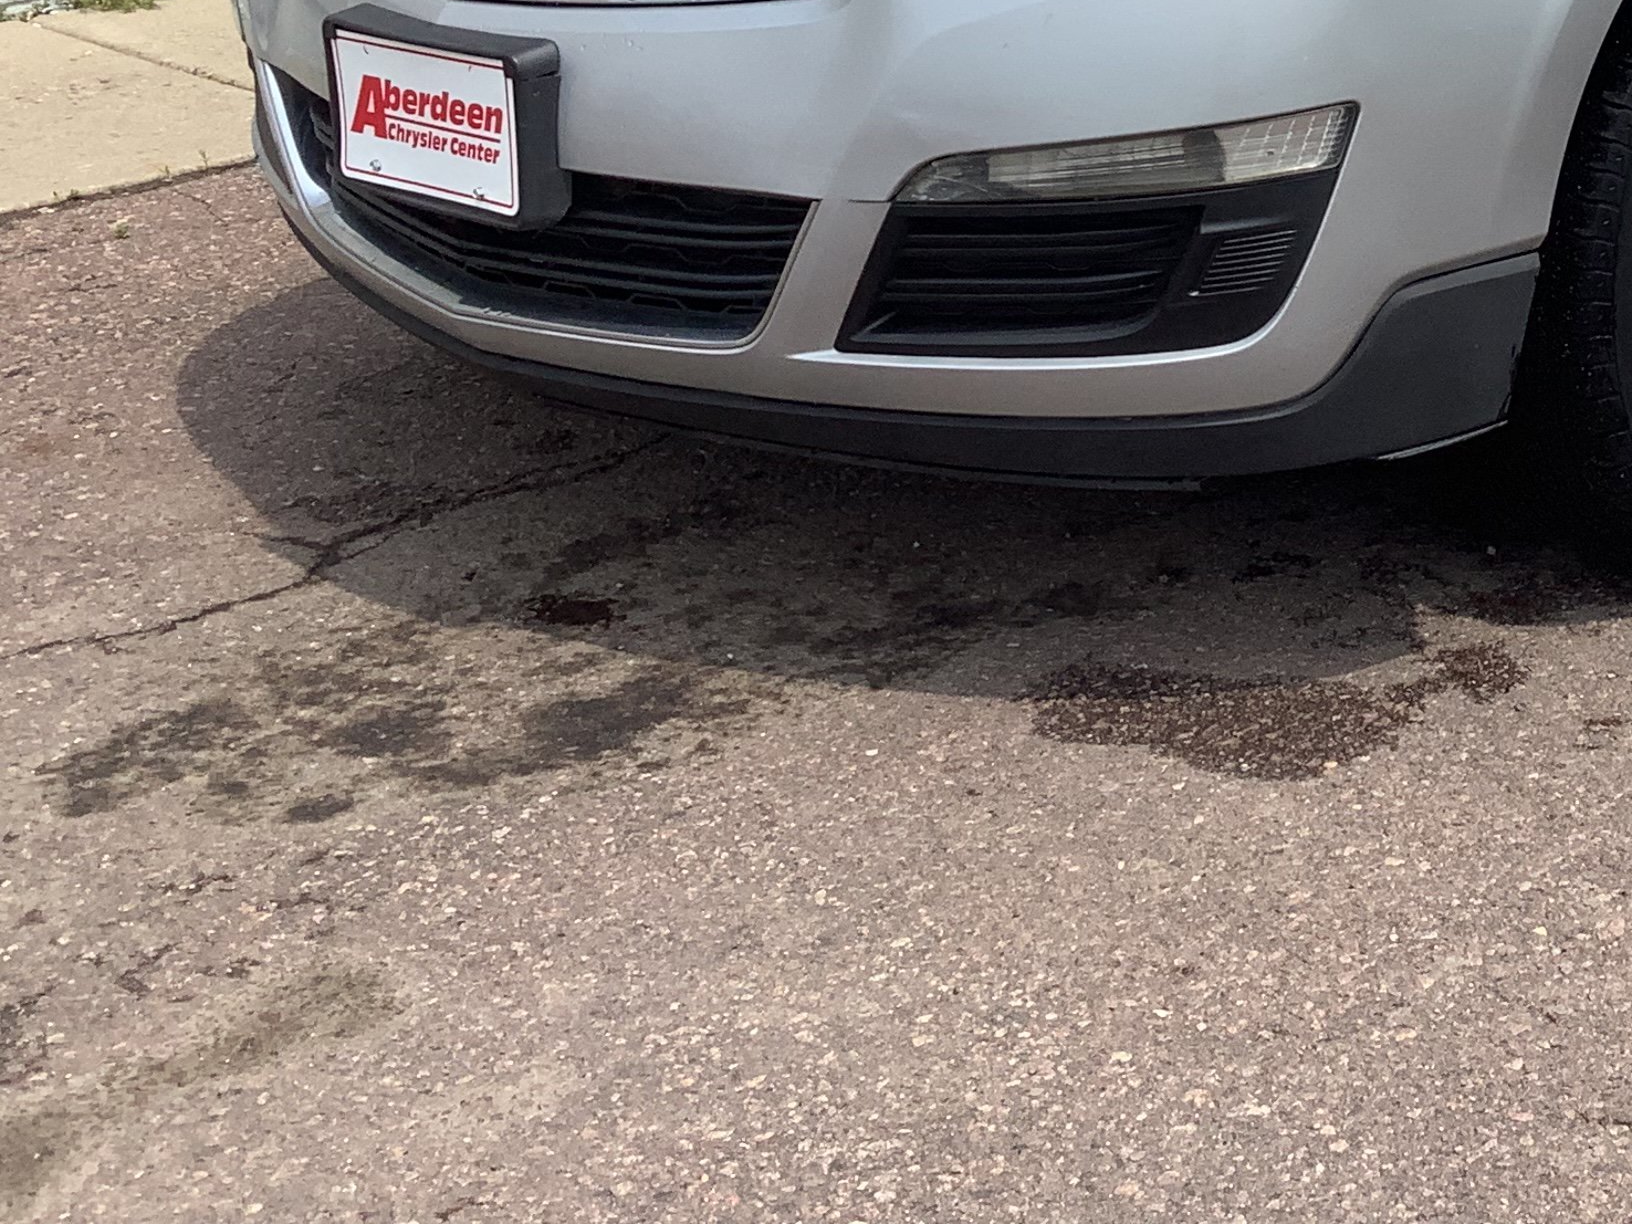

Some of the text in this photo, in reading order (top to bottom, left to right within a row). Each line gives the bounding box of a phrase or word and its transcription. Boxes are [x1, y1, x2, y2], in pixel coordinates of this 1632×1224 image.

[351, 74, 503, 140] Aberdeen
[387, 123, 501, 165] Chrysler Center
